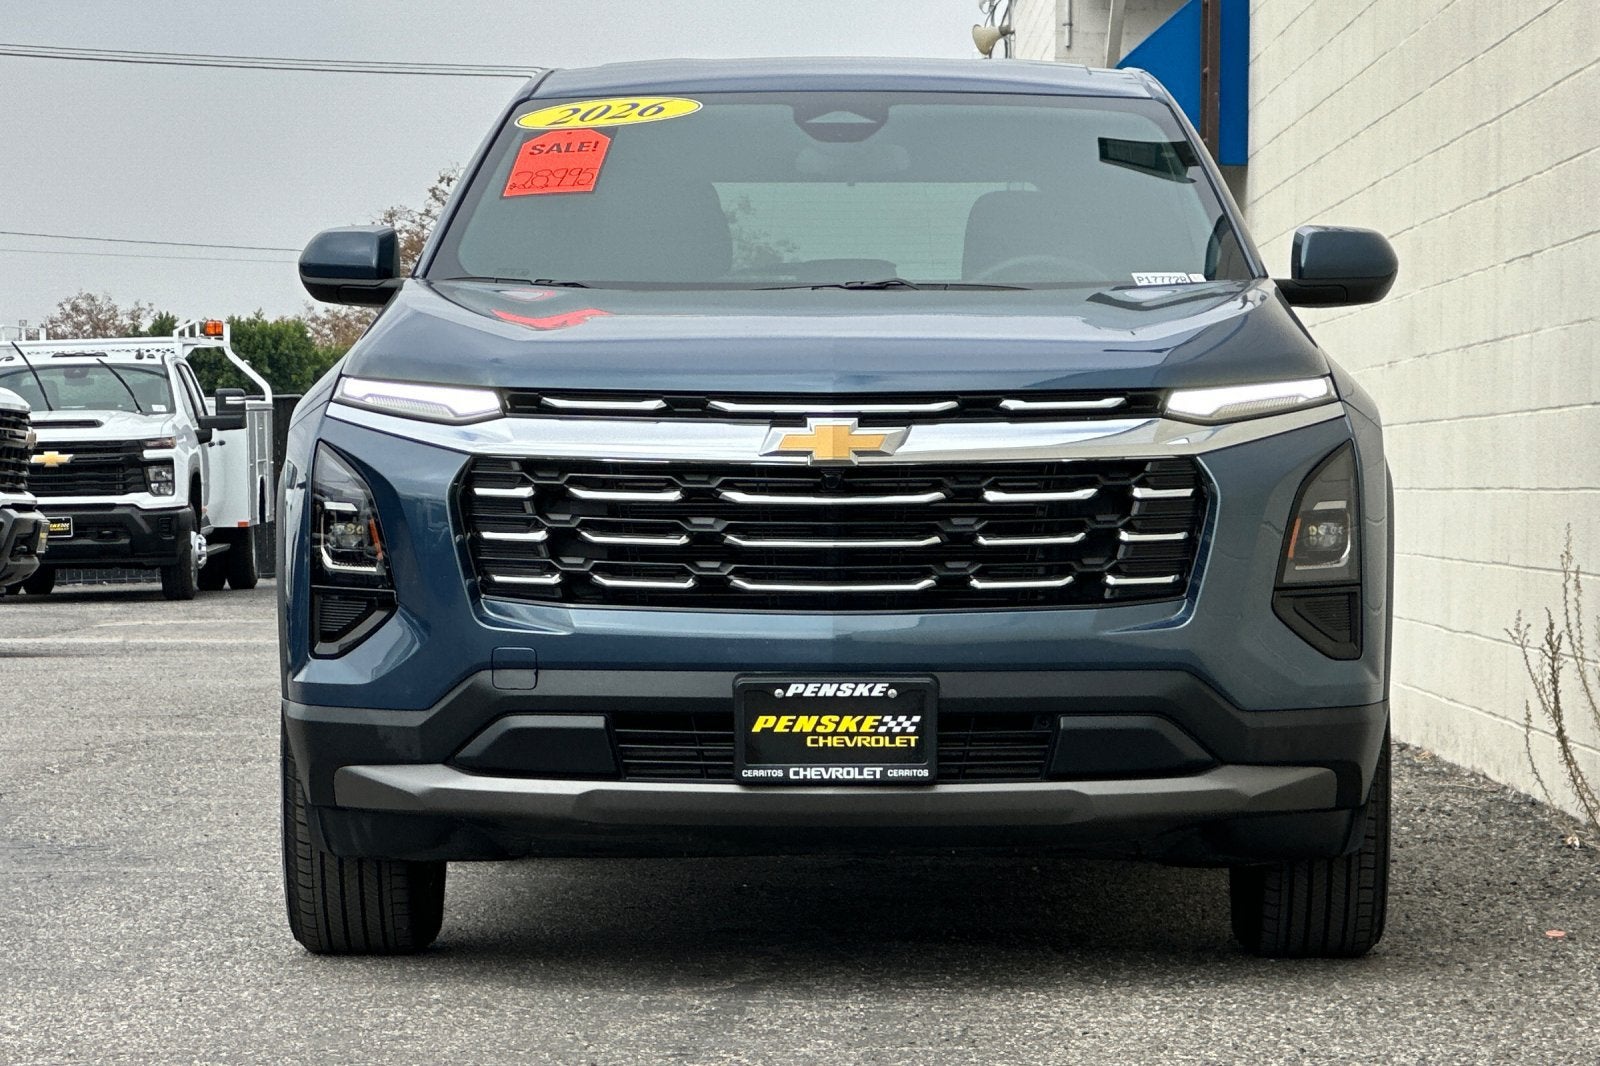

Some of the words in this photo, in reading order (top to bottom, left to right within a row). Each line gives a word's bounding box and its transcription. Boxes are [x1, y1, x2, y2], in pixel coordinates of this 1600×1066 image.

[546, 100, 674, 126] 2026
[529, 141, 600, 156] SALE!
[785, 683, 890, 697] PENSKE
[751, 715, 883, 733] PENSKE
[806, 736, 919, 748] CHEVROLET
[742, 769, 784, 778] CERRITOS
[789, 767, 884, 780] CHEVROLET
[887, 769, 929, 778] CERRITOS
